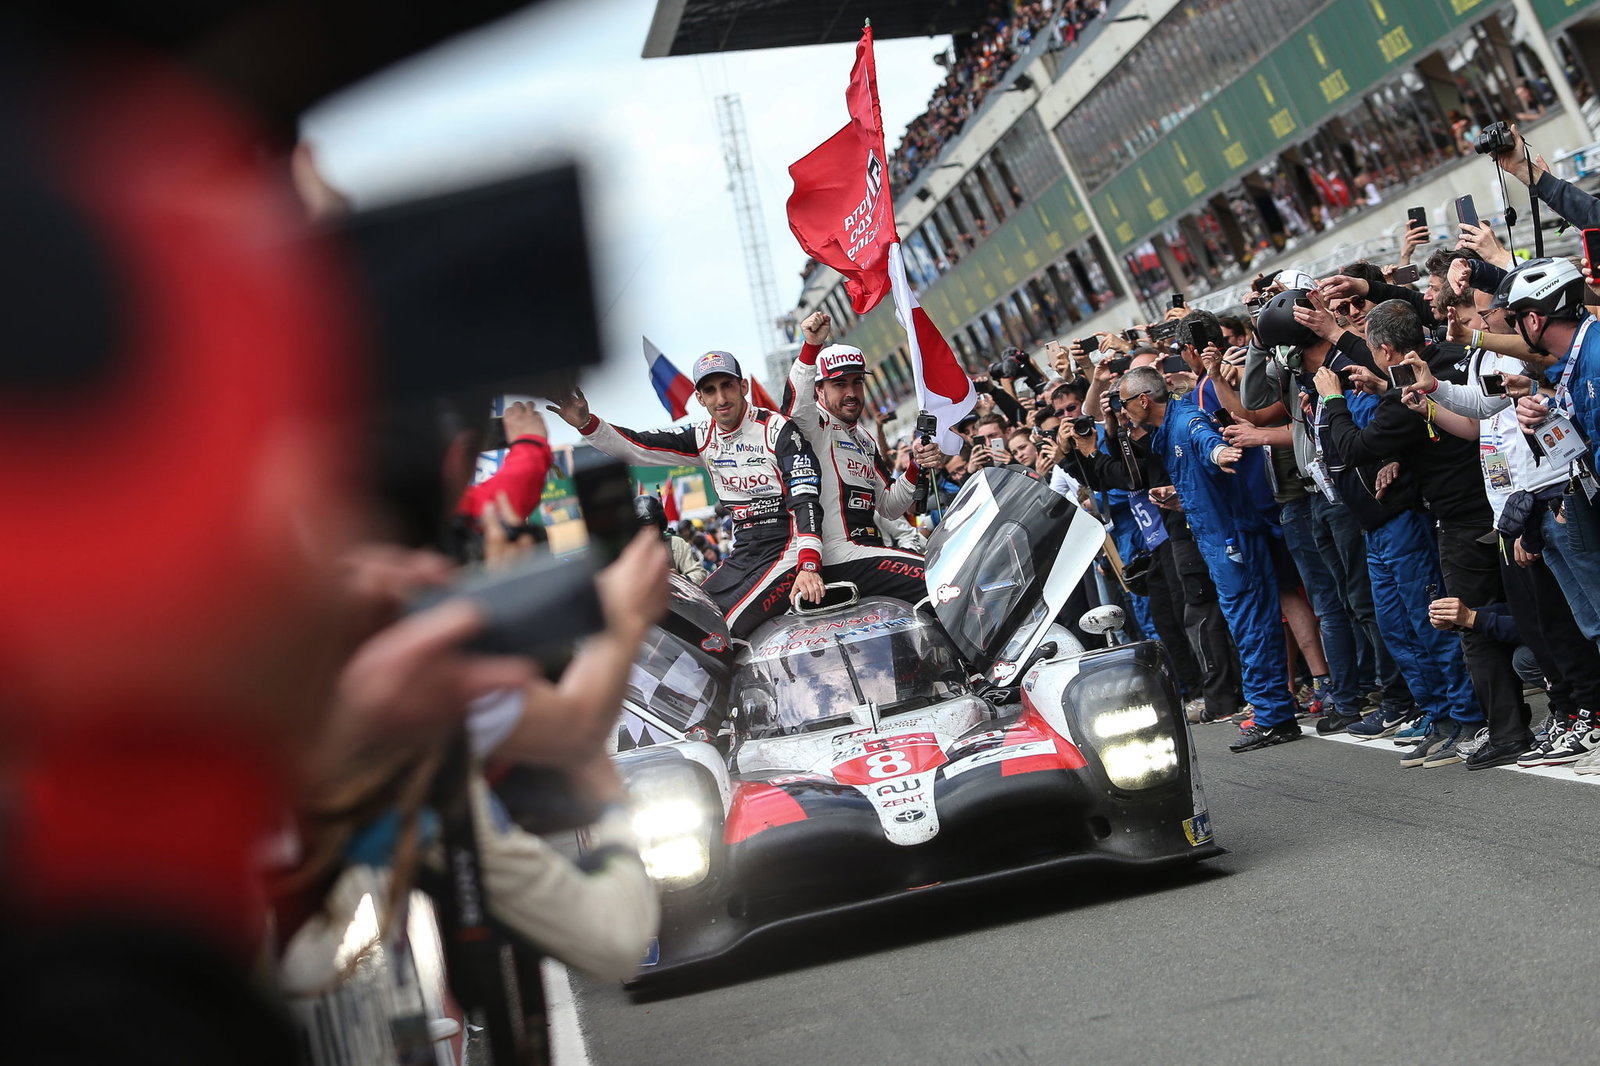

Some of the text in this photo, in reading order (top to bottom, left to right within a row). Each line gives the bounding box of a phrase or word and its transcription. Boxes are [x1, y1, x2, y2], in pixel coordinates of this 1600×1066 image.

[736, 443, 759, 453] Mobil
[720, 474, 769, 490] DENSO
[788, 614, 881, 641] DENSO
[760, 636, 829, 657] TOYOTA
[867, 735, 935, 750] TOTAL
[866, 751, 913, 779] 8
[881, 792, 925, 809] ZENT
